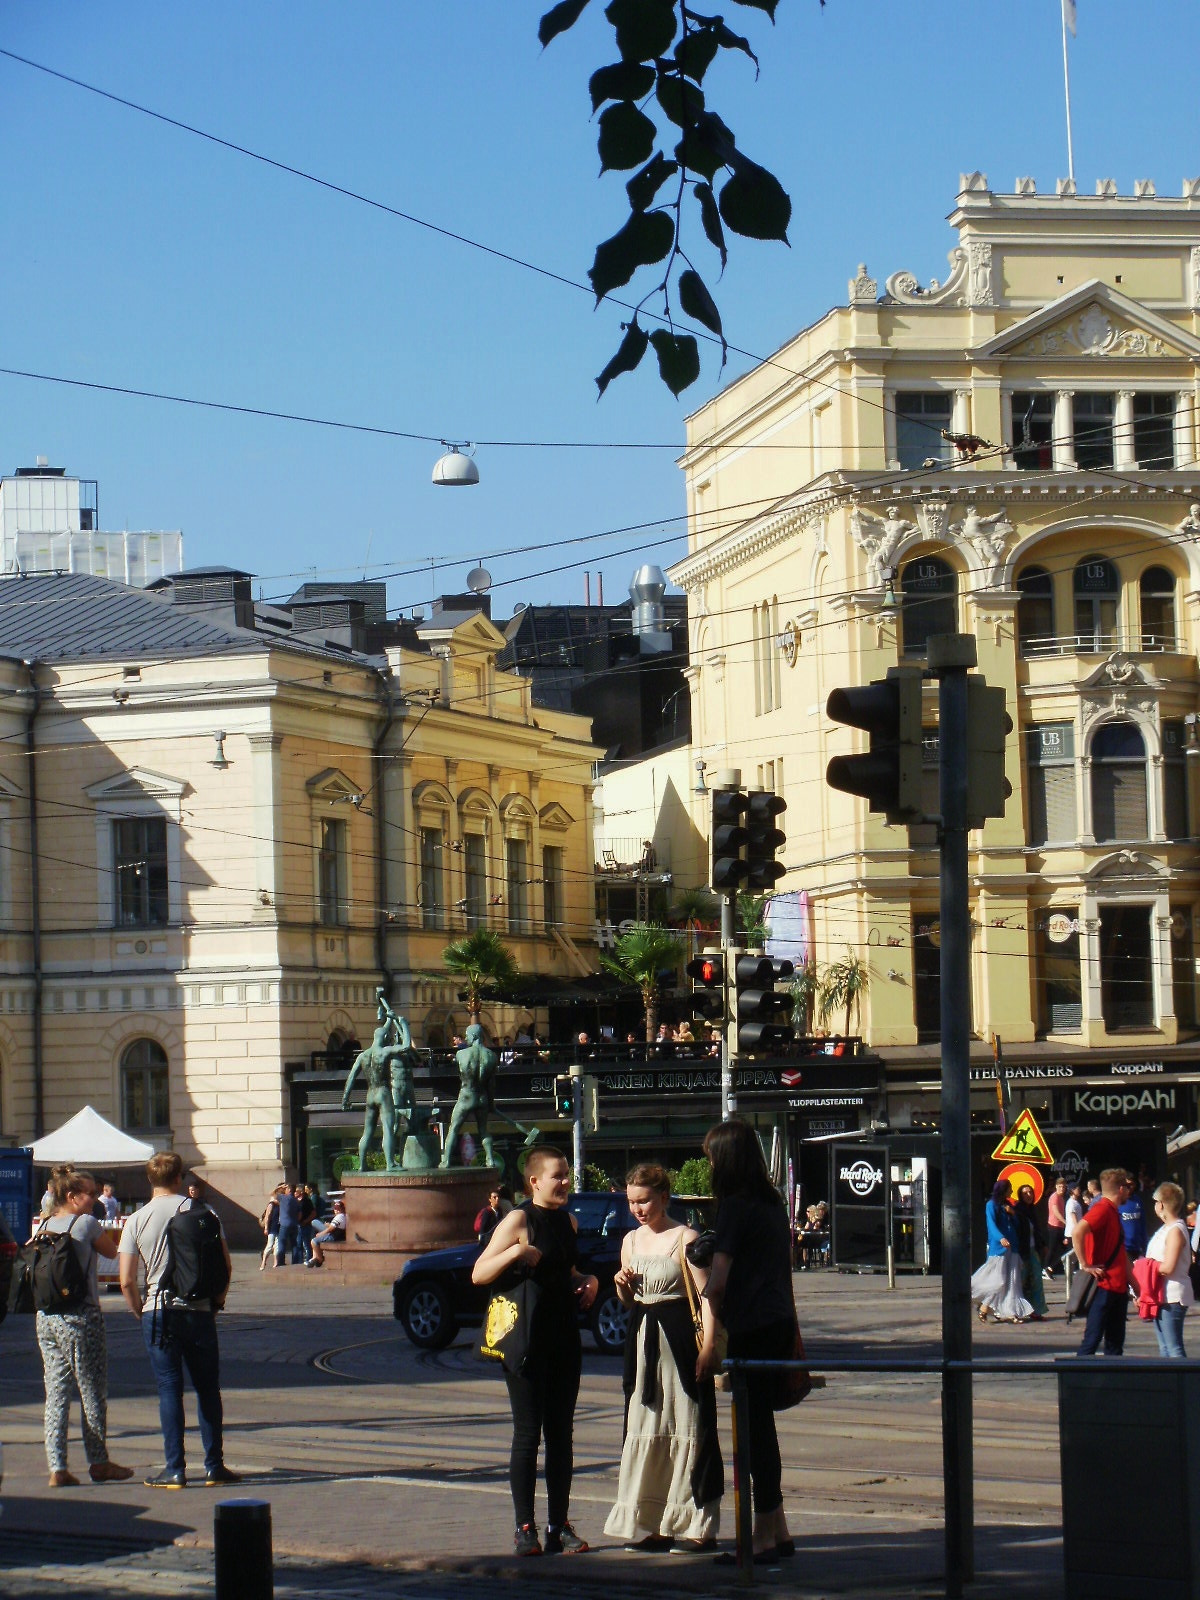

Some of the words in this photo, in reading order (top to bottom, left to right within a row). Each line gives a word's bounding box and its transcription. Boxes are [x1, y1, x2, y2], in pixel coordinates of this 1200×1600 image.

[1041, 732, 1060, 746] UB
[1005, 1064, 1074, 1079] BANKERS
[1111, 1062, 1163, 1075] KappAhl
[788, 1097, 864, 1107] YLIOPPILASTEATTERI
[1075, 1090, 1175, 1114] KappAhl
[840, 1167, 861, 1180] Hard
[861, 1167, 883, 1184] Rock
